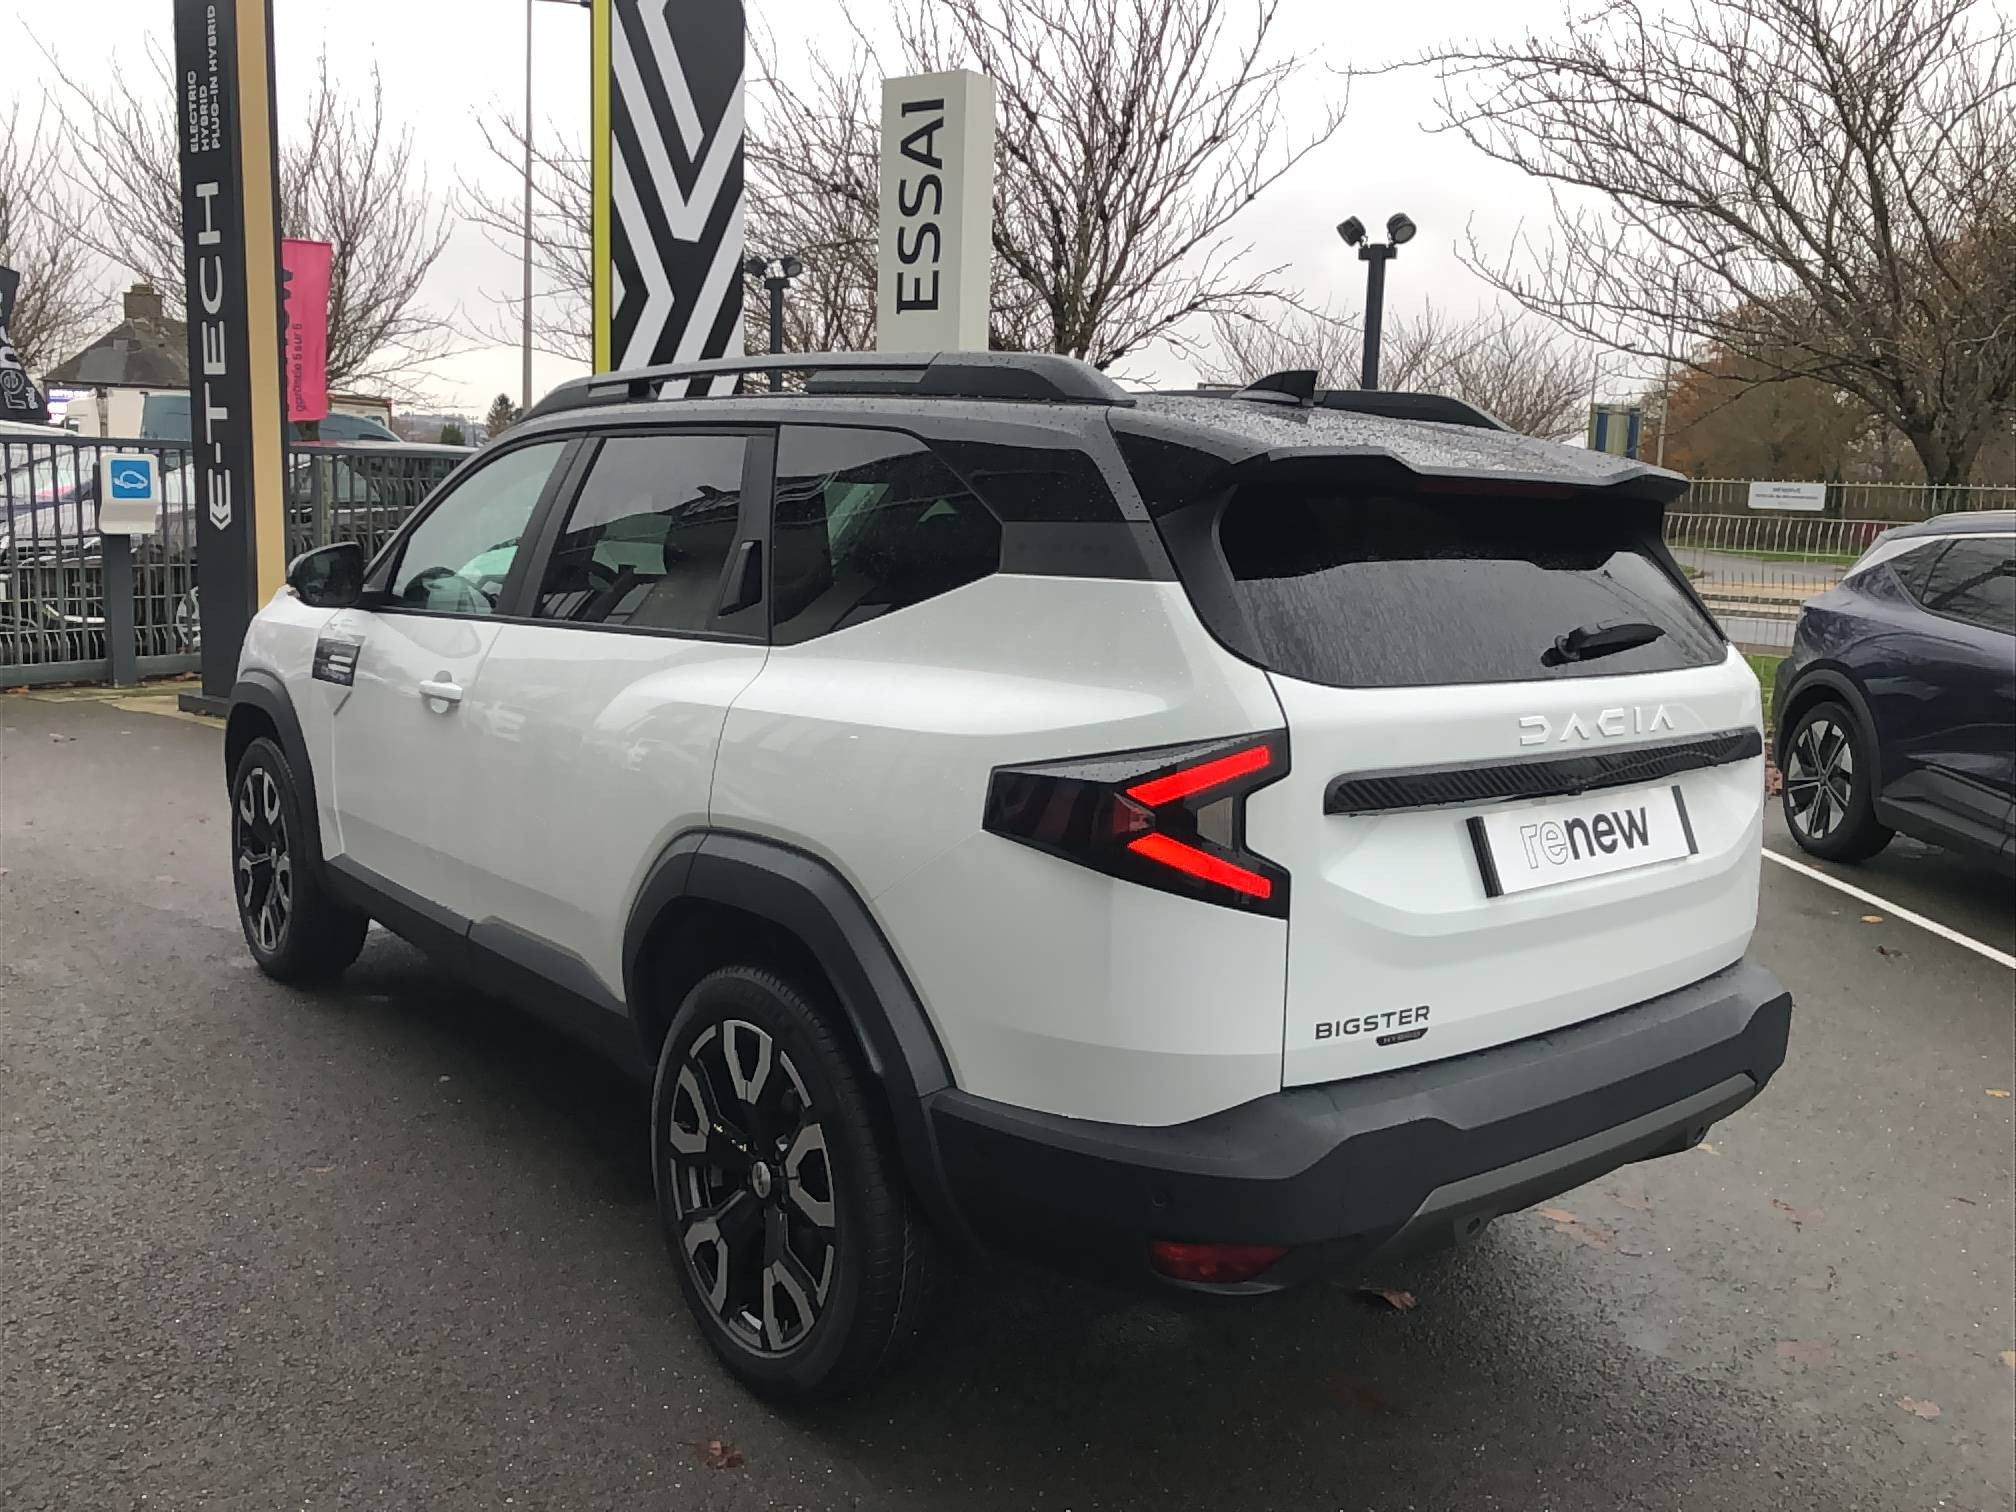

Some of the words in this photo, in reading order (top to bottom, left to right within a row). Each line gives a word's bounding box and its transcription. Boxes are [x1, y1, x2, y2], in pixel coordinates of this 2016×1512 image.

[206, 5, 218, 72] HYBRID
[187, 71, 199, 153] ELECTRIC
[199, 85, 210, 151] HYBRID
[209, 75, 221, 149] PLUG-IN
[896, 98, 944, 315] ESSAI
[196, 182, 232, 531] E-TECH
[293, 332, 303, 351] sur
[1519, 704, 1675, 746] DACIA
[1519, 806, 1649, 869] renew
[1315, 1005, 1430, 1040] BIGSTER
